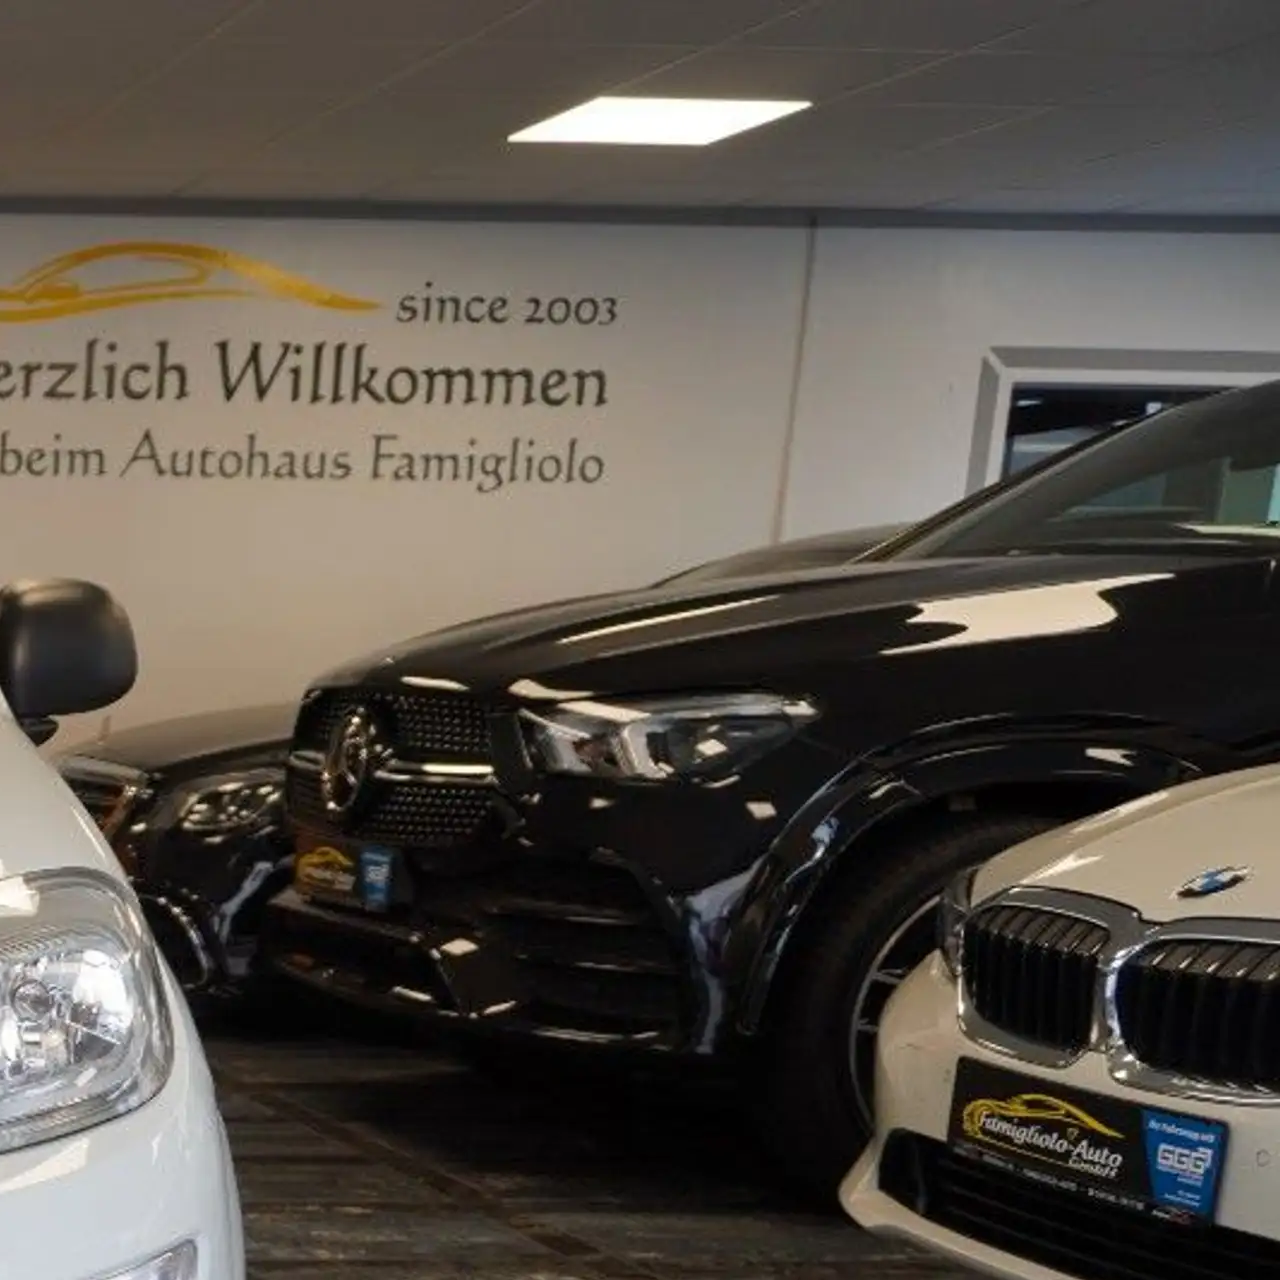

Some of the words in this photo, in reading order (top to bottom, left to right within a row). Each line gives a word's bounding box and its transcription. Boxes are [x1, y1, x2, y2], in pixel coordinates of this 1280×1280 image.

[395, 281, 510, 324] since
[523, 296, 618, 325] 2003
[214, 338, 610, 407] Willkommen
[119, 427, 353, 480] Autohaus
[370, 433, 605, 493] Famigliolo
